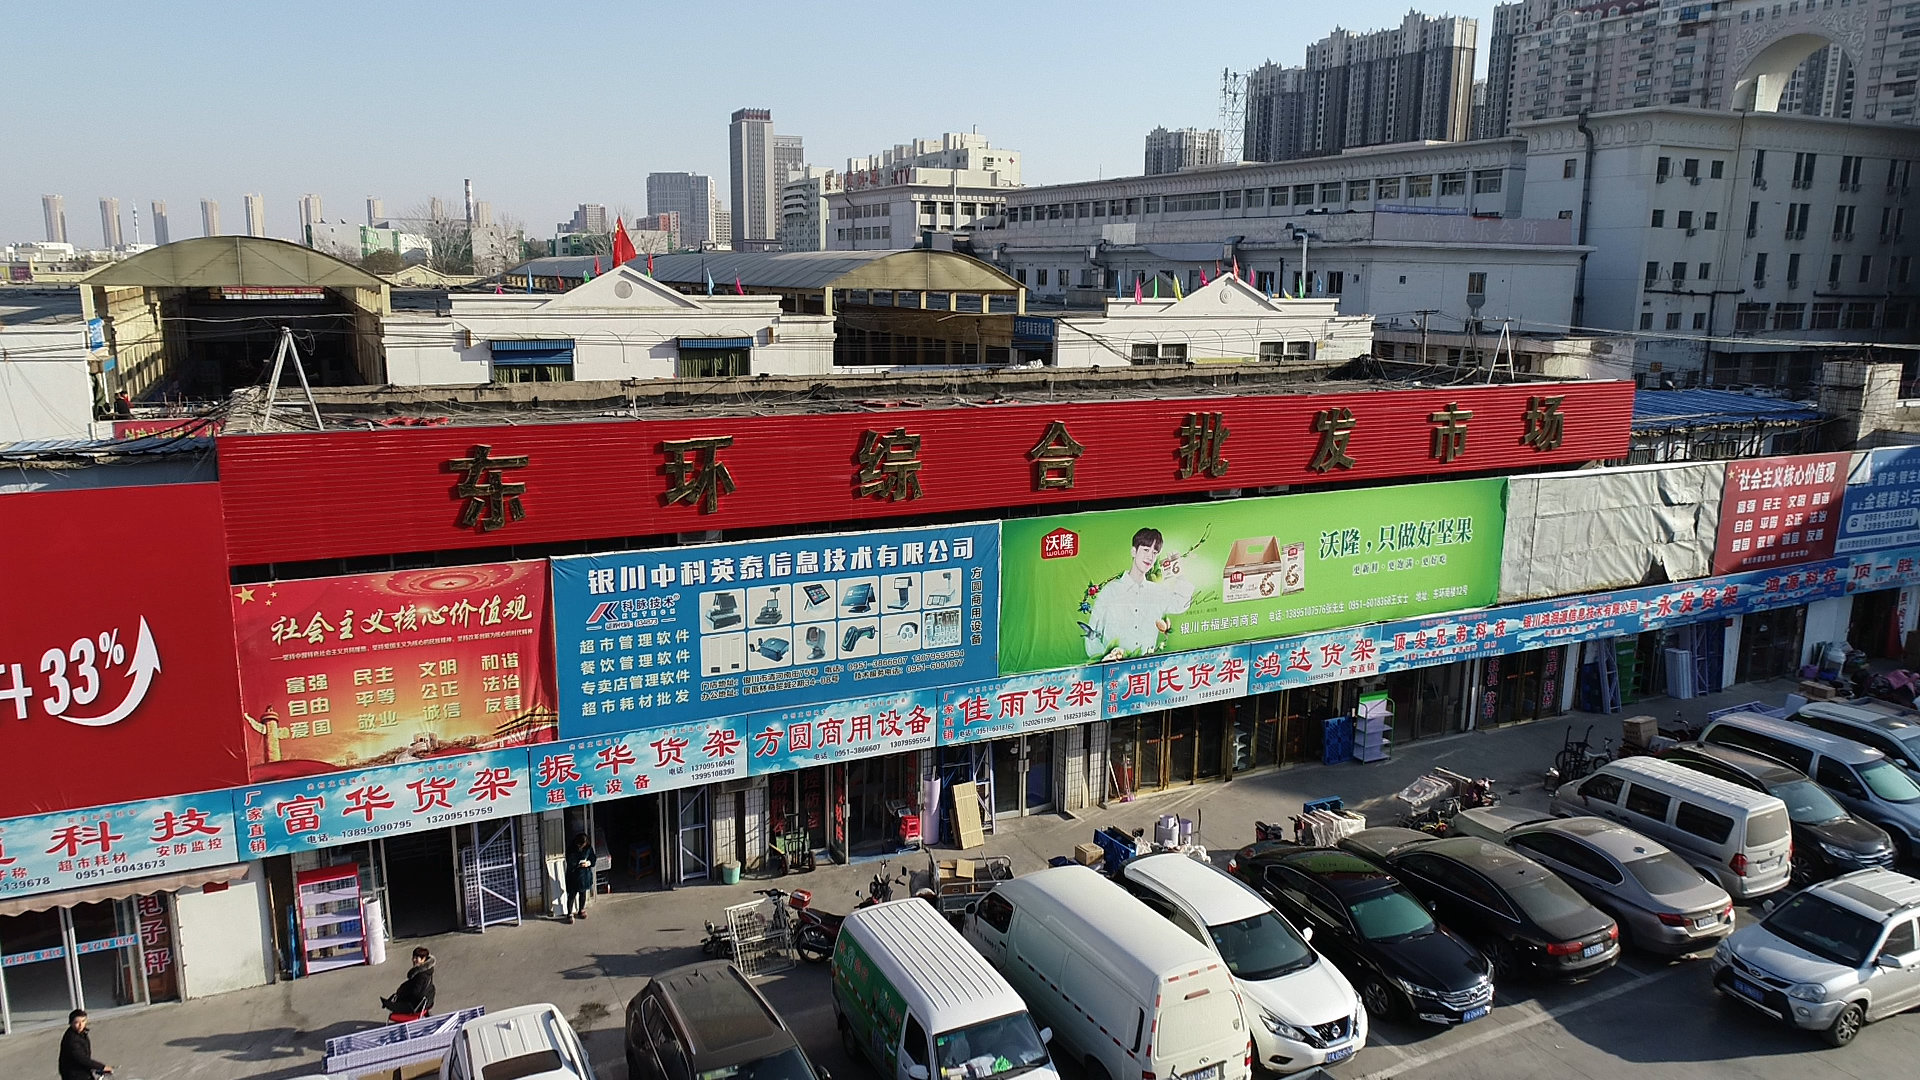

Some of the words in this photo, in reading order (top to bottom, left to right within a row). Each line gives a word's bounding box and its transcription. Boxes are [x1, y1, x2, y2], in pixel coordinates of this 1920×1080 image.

[894, 167, 911, 185] KTV
[449, 394, 1565, 531] 东环综合批发市场
[1738, 462, 1836, 492] 社会主义核心价值观
[1737, 500, 1756, 514] 富强
[1762, 497, 1781, 511] 民主
[1787, 494, 1806, 508] 文明
[1812, 492, 1830, 505] 和谐
[1734, 519, 1753, 533] 自由
[1759, 516, 1778, 530] 平等
[1785, 513, 1803, 527] 公正
[1809, 511, 1827, 524] 法治
[1046, 534, 1075, 551] 沃隆
[1731, 538, 1750, 552] 爱国
[1756, 535, 1775, 549] 敬业
[1782, 532, 1800, 545] 诚信
[1806, 529, 1824, 542] 友善
[588, 537, 974, 595] 银川中科英泰信息技术有限公司
[1764, 567, 1838, 594] 鸿源科技
[1852, 557, 1920, 580] 顶一胜
[621, 597, 675, 612] 科脉技术
[971, 567, 982, 645] 方圆商用设备
[1657, 585, 1738, 617] 永发货架
[271, 593, 533, 646] 社会主义核心价值观
[1180, 613, 1259, 635] 银川市福星河商贸
[579, 629, 690, 655] 超市管理软件
[1393, 618, 1507, 652] 顶尖兄弟科技
[285, 674, 328, 694] 富强
[354, 666, 394, 686] 民主
[419, 659, 458, 677] 文明
[481, 652, 519, 671] 和谐
[580, 649, 690, 676] 餐饮管理软件
[847, 656, 908, 670] 0951-3866607
[1254, 638, 1377, 678] 鸿达货架
[1340, 662, 1376, 676] 厂家直销
[581, 670, 690, 696] 专卖店管理软件
[1108, 667, 1119, 713] 厂家直销
[1122, 658, 1245, 700] 周氏货架
[287, 697, 330, 717] 自由
[355, 689, 395, 708] 平等
[421, 681, 459, 699] 公正
[482, 674, 520, 692] 法治
[582, 690, 690, 717] 超市耗材批发
[958, 680, 1098, 726] 佳雨货架
[289, 720, 332, 739] 爱国
[358, 711, 398, 730] 敬业
[423, 702, 461, 721] 诚信
[484, 694, 521, 714] 友善
[943, 690, 954, 740] 厂家直销
[755, 705, 932, 758] 方圆商用设备
[537, 730, 741, 787] 振华货架
[835, 744, 881, 758] 0951-3866607
[890, 736, 931, 749] 13079595554
[276, 766, 518, 835] 富华货架
[547, 774, 650, 804] 超市设备
[245, 790, 266, 853] 厂家直销
[341, 820, 412, 838] 13895090795
[426, 806, 493, 824] 13209515759
[58, 852, 129, 872] 超市耗材
[157, 837, 223, 858] 安防监控
[75, 859, 166, 880] 0951-6043673
